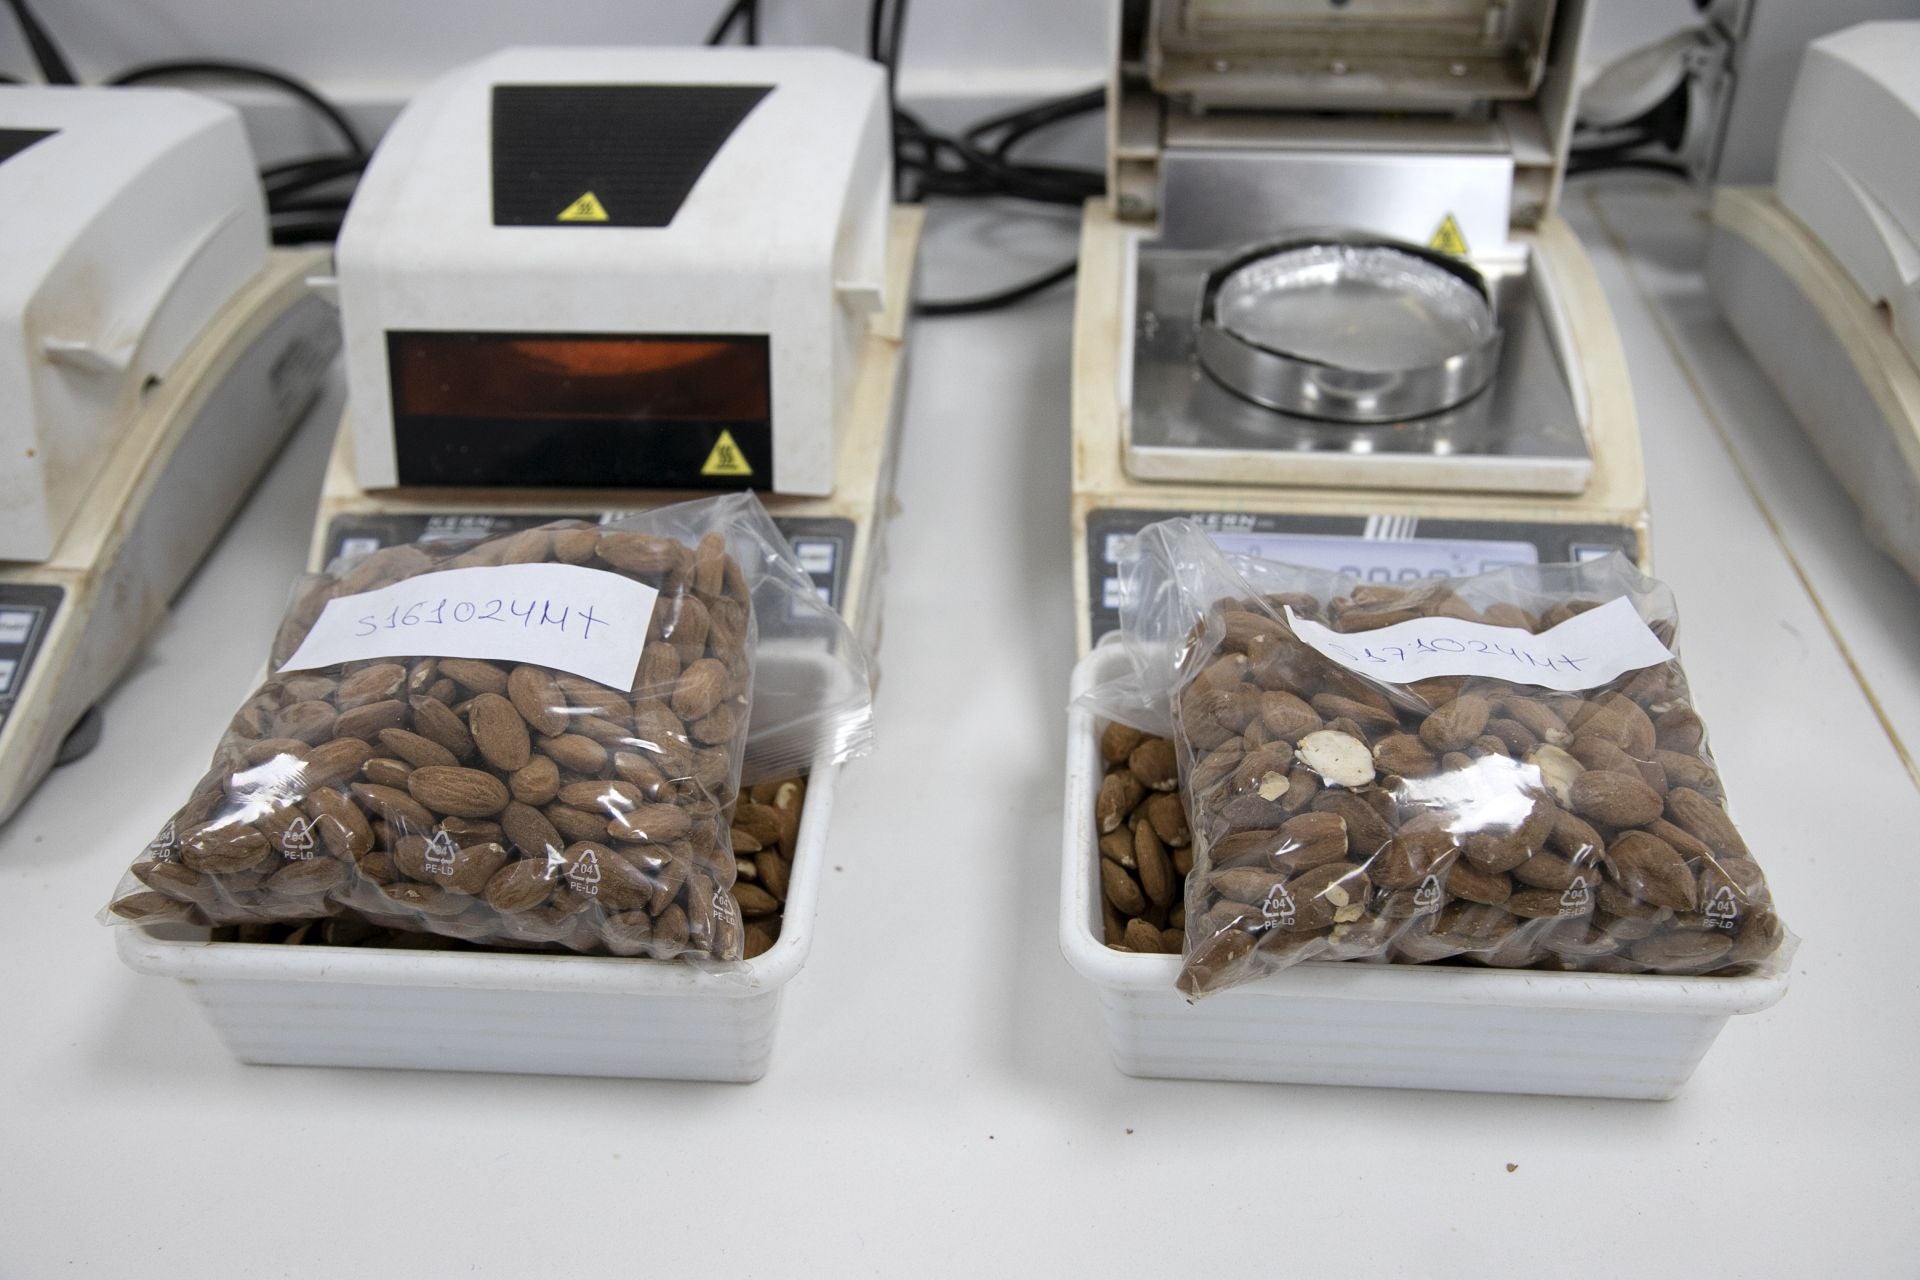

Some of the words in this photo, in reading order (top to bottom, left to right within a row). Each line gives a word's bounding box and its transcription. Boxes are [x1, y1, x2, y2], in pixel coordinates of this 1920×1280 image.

[284, 850, 314, 860] PE-LD
[425, 863, 454, 876] PE-LD
[580, 864, 593, 875] 04
[570, 881, 599, 895] PE-LD
[1424, 888, 1436, 898] 04
[1571, 890, 1582, 899] 04
[1272, 899, 1286, 909] 04
[1717, 901, 1730, 911] 04
[1264, 917, 1295, 930] PE-LD
